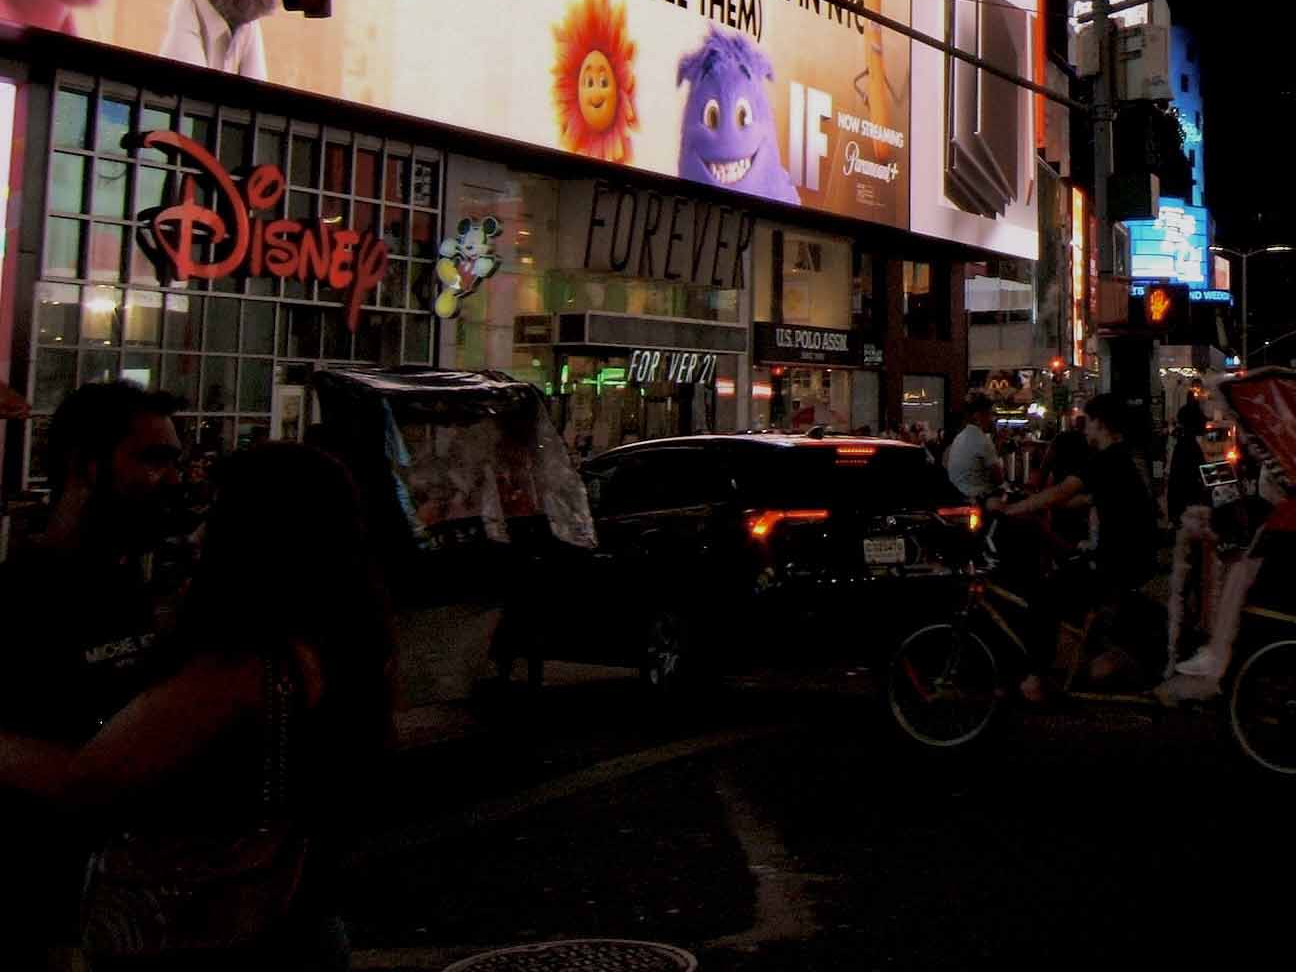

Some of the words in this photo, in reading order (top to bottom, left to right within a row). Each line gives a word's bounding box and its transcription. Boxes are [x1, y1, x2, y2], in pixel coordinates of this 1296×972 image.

[789, 79, 833, 192] IF
[837, 111, 860, 134] NOW
[860, 119, 905, 149] STREAMING
[583, 178, 756, 290] FOREVER
[700, 354, 717, 385] 21
[775, 328, 793, 347] U.S.
[794, 329, 821, 350] POLO
